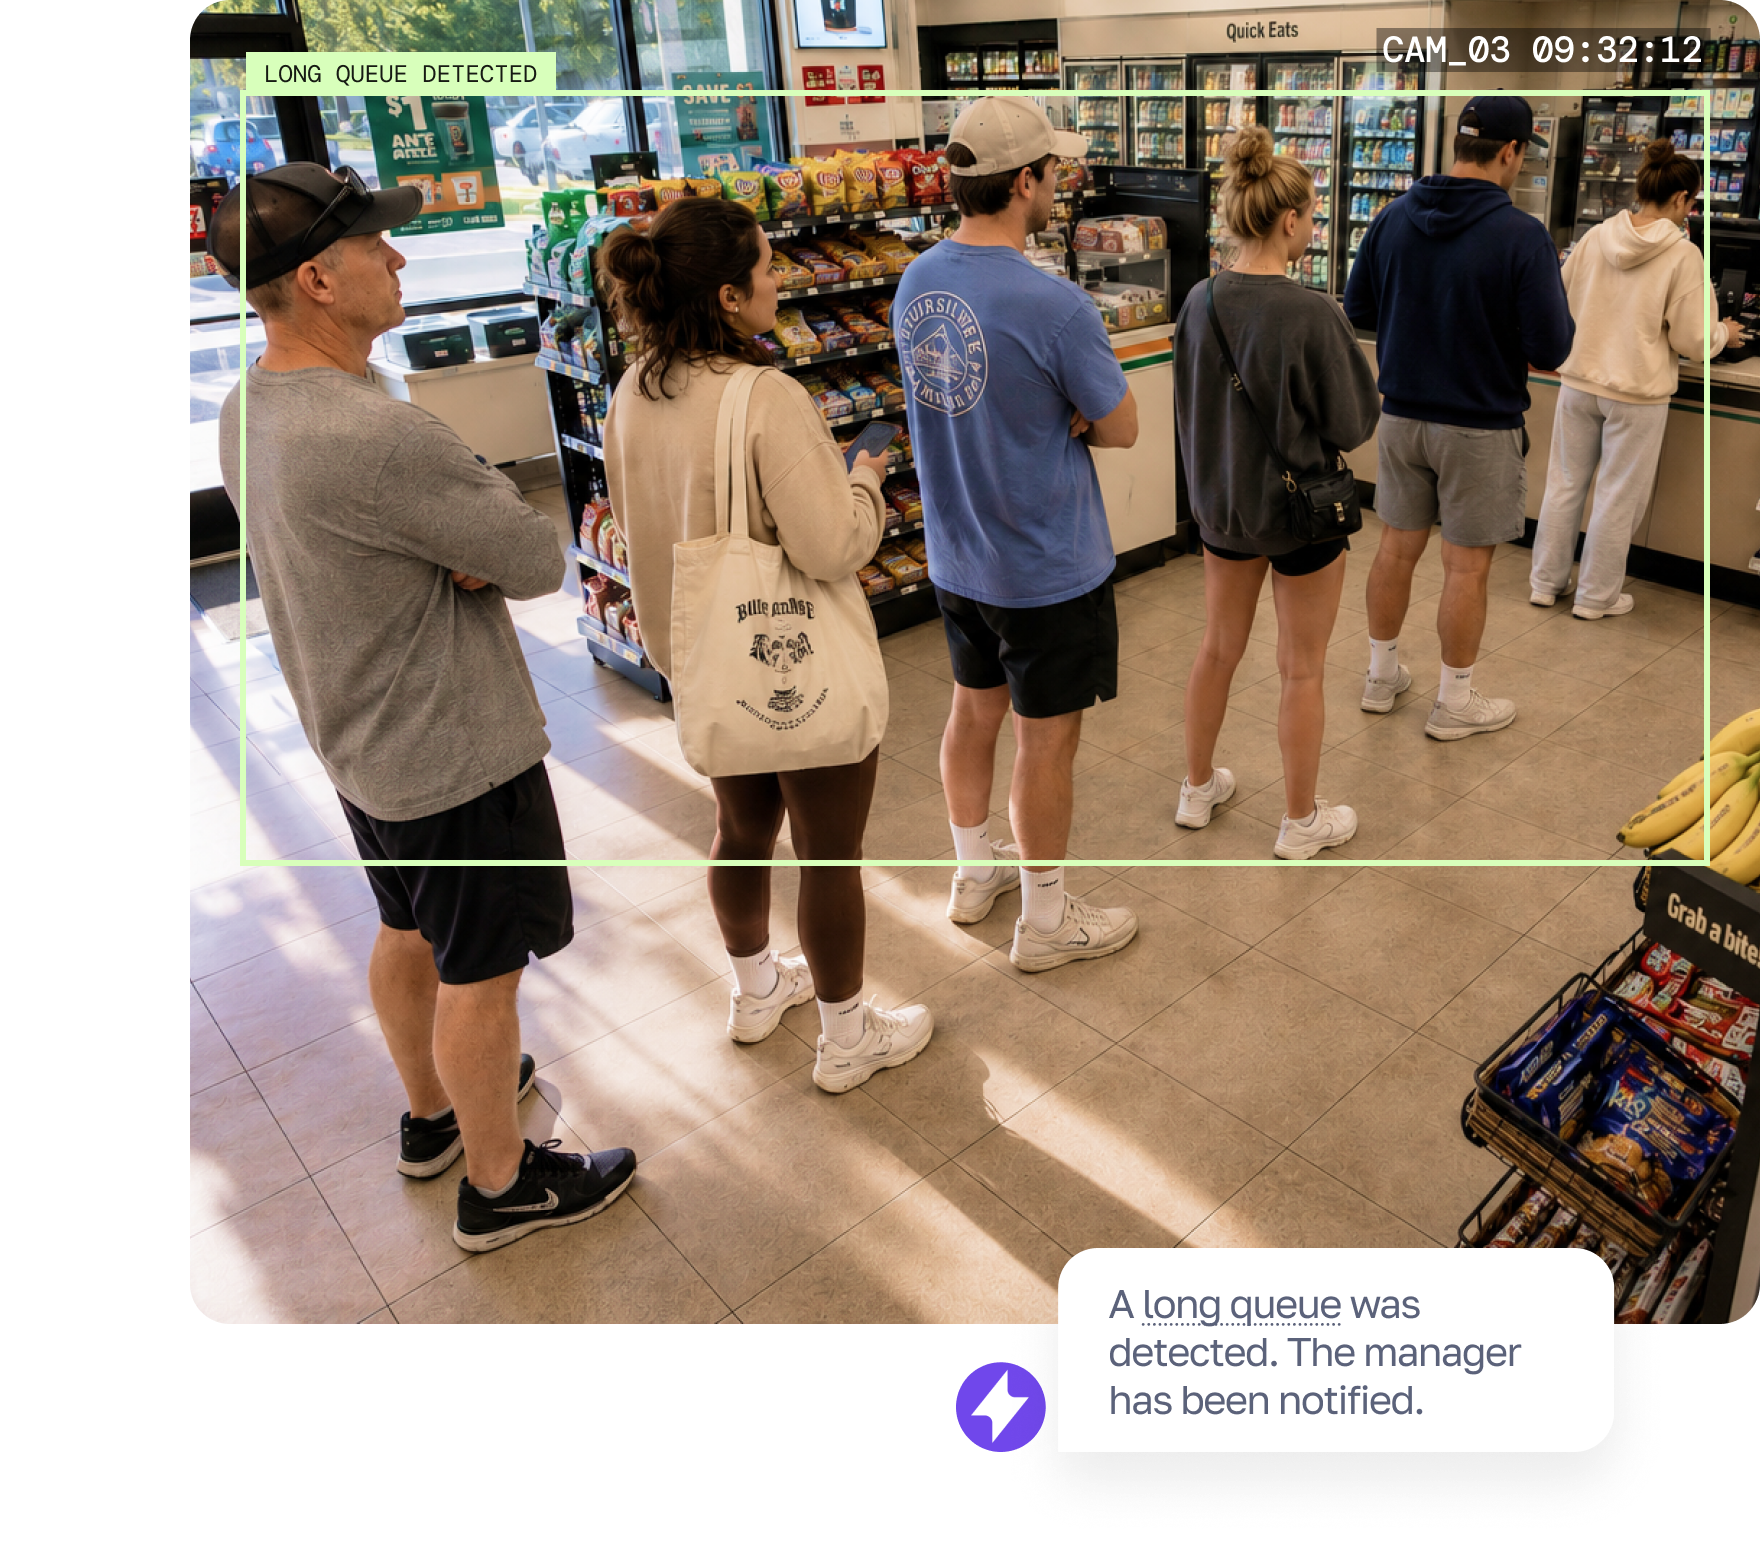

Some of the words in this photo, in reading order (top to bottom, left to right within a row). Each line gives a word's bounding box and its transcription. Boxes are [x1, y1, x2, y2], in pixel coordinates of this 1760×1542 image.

[1227, 22, 1265, 43] Quick
[1269, 21, 1299, 38] Eats
[1667, 892, 1708, 935] Grab
[1709, 921, 1723, 945] a
